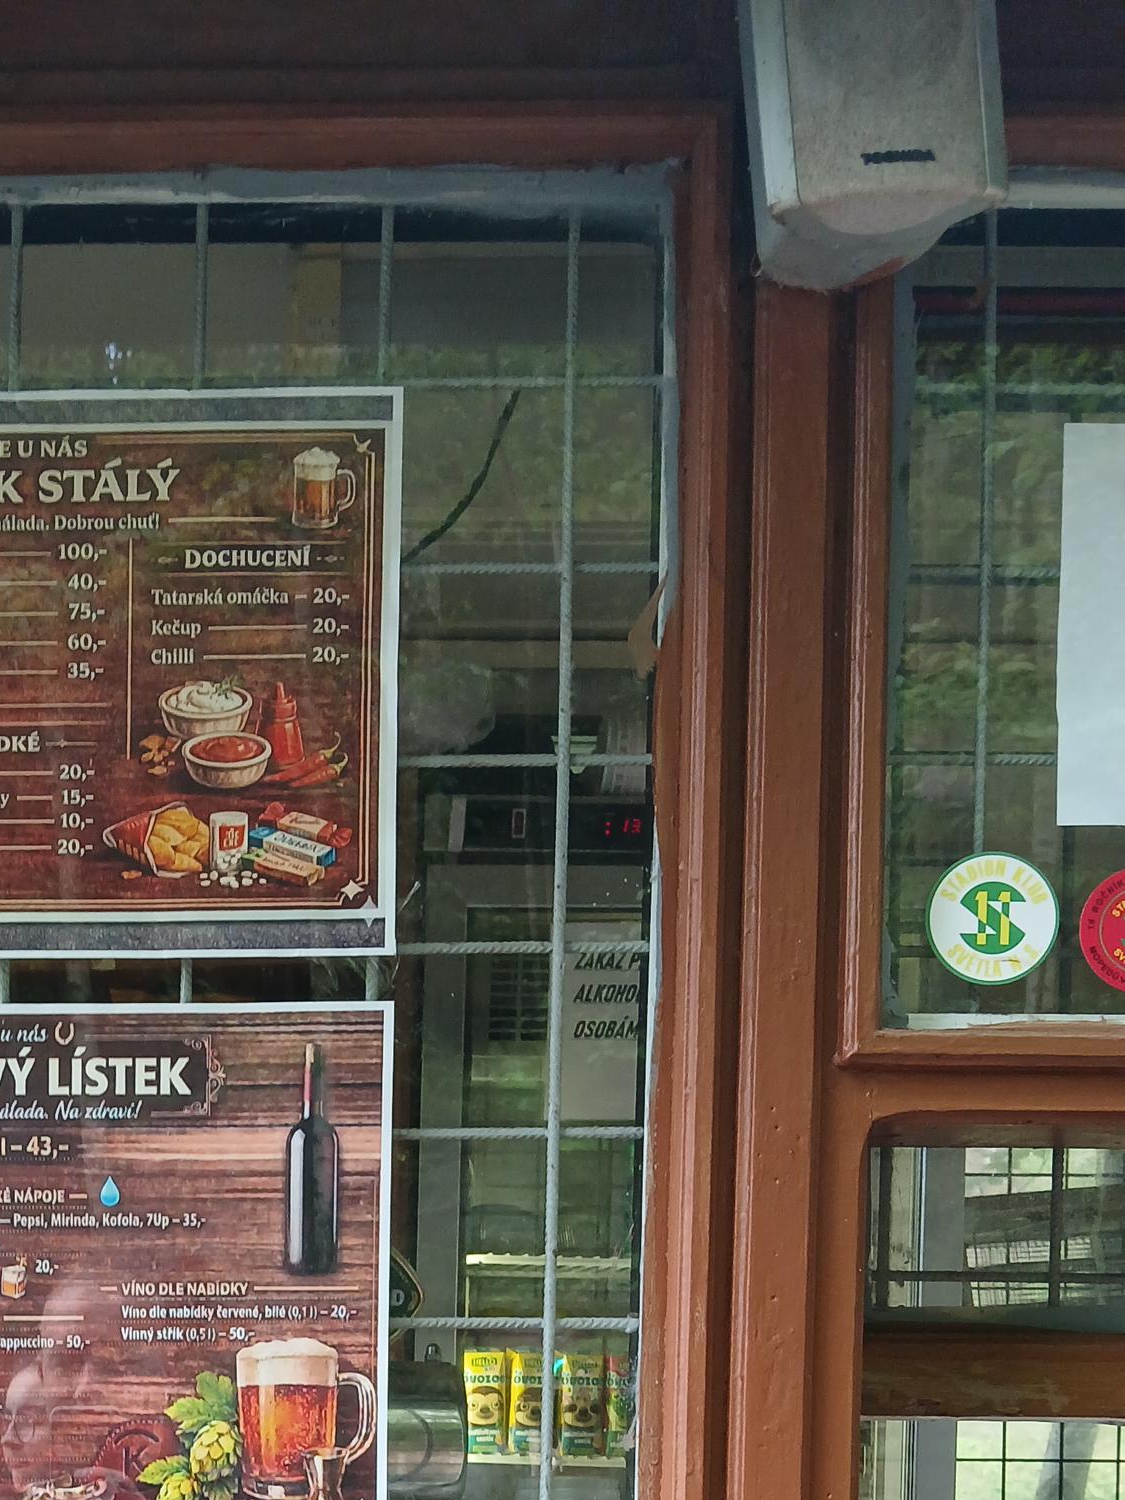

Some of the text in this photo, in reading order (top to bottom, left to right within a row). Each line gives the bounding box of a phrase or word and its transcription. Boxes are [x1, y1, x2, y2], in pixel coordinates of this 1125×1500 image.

[17, 440, 34, 458] U
[40, 436, 88, 458] NÁS
[38, 457, 179, 502] STÁLÝ
[54, 513, 114, 531] Dobrou
[118, 513, 160, 530] chuť!
[185, 545, 311, 569] DOCHUCENÍ
[151, 587, 289, 606] Tatarská omáčka
[151, 619, 201, 640] Kečup
[151, 648, 194, 664] Chilli
[574, 984, 640, 1003] ALKOHO
[17, 1026, 47, 1043] nás
[47, 1045, 191, 1097] LÍSTEK
[55, 1100, 81, 1121] Na
[85, 1100, 142, 1120] zdraví!
[14, 1187, 65, 1203] NÁPOJE
[13, 1213, 48, 1231] Pepsi,
[51, 1213, 99, 1229] Mirinda,
[103, 1213, 143, 1229] Kofola,
[147, 1213, 169, 1230] 7Up
[121, 1279, 248, 1296] VÍNO DLE NABÍDKY
[121, 1305, 146, 1319] Víno
[149, 1305, 167, 1319] dle
[169, 1305, 213, 1321] nabídky
